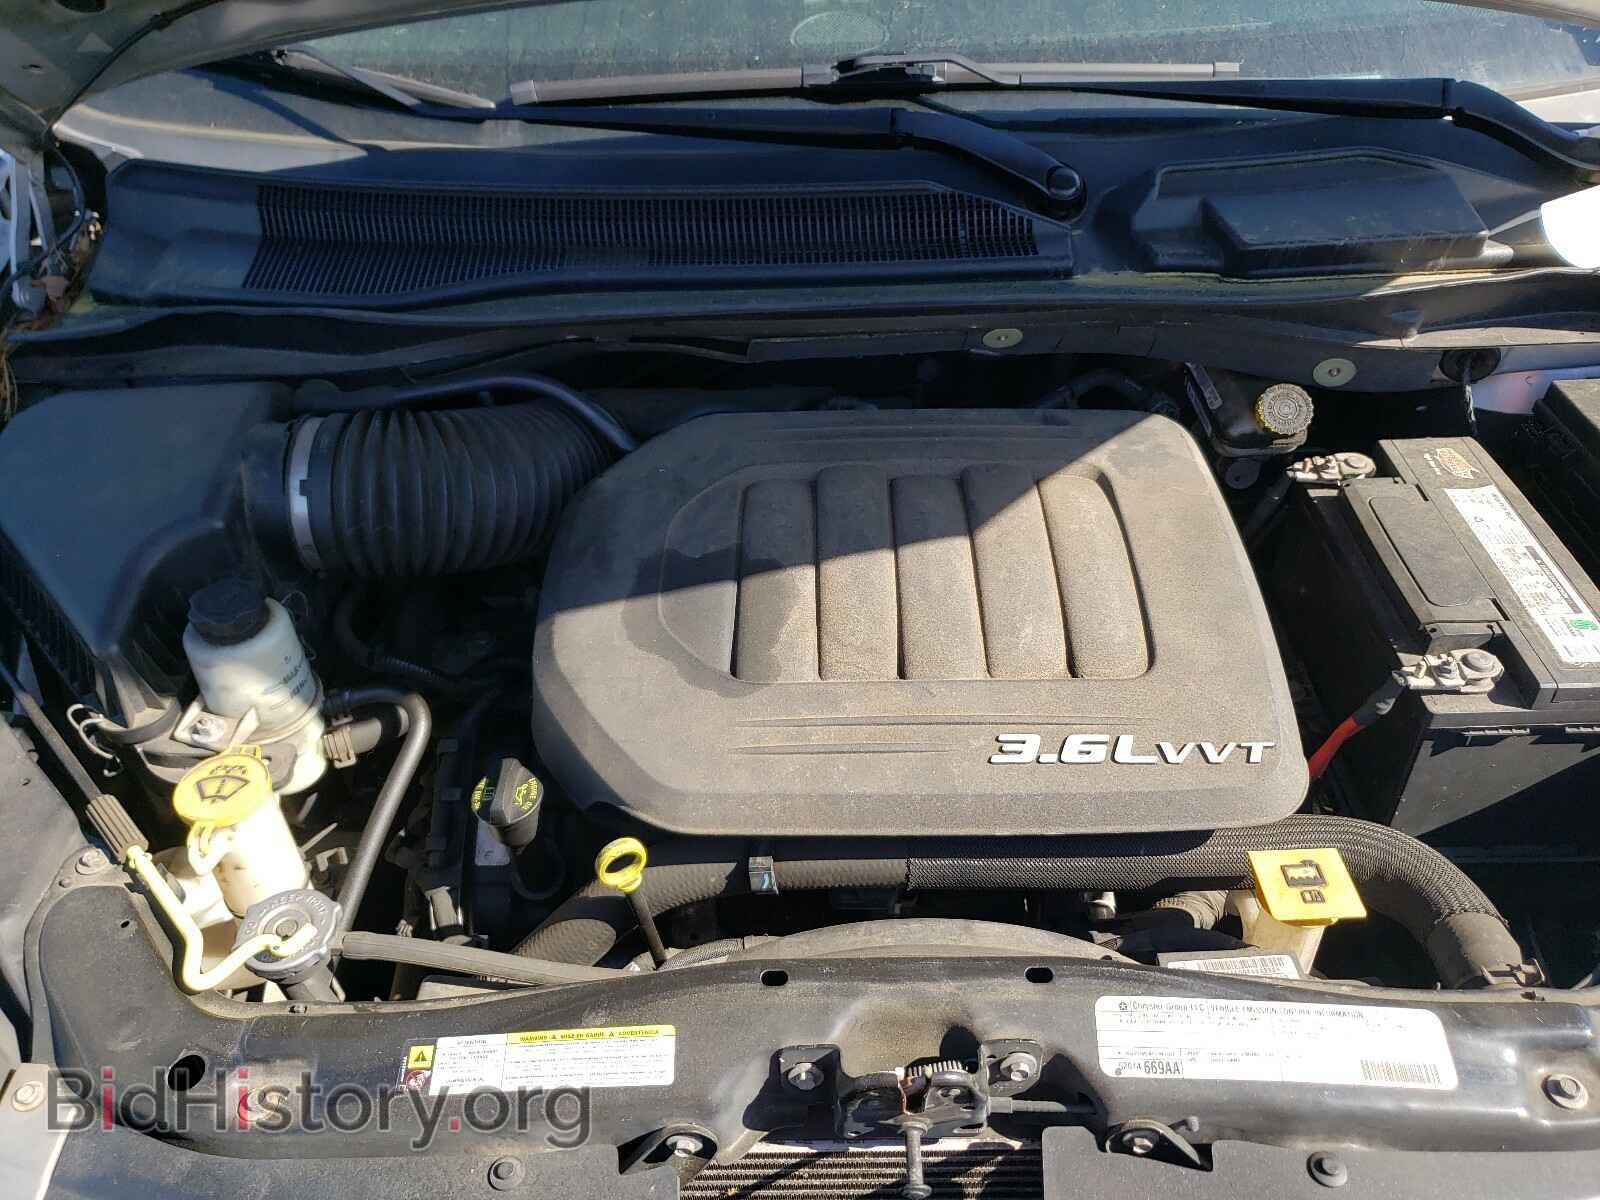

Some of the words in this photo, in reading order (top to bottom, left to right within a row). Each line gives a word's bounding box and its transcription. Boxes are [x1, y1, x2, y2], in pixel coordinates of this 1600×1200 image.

[988, 733, 1160, 764] 3.6L
[1156, 741, 1278, 764] VVT
[1143, 1060, 1181, 1075] 669AA
